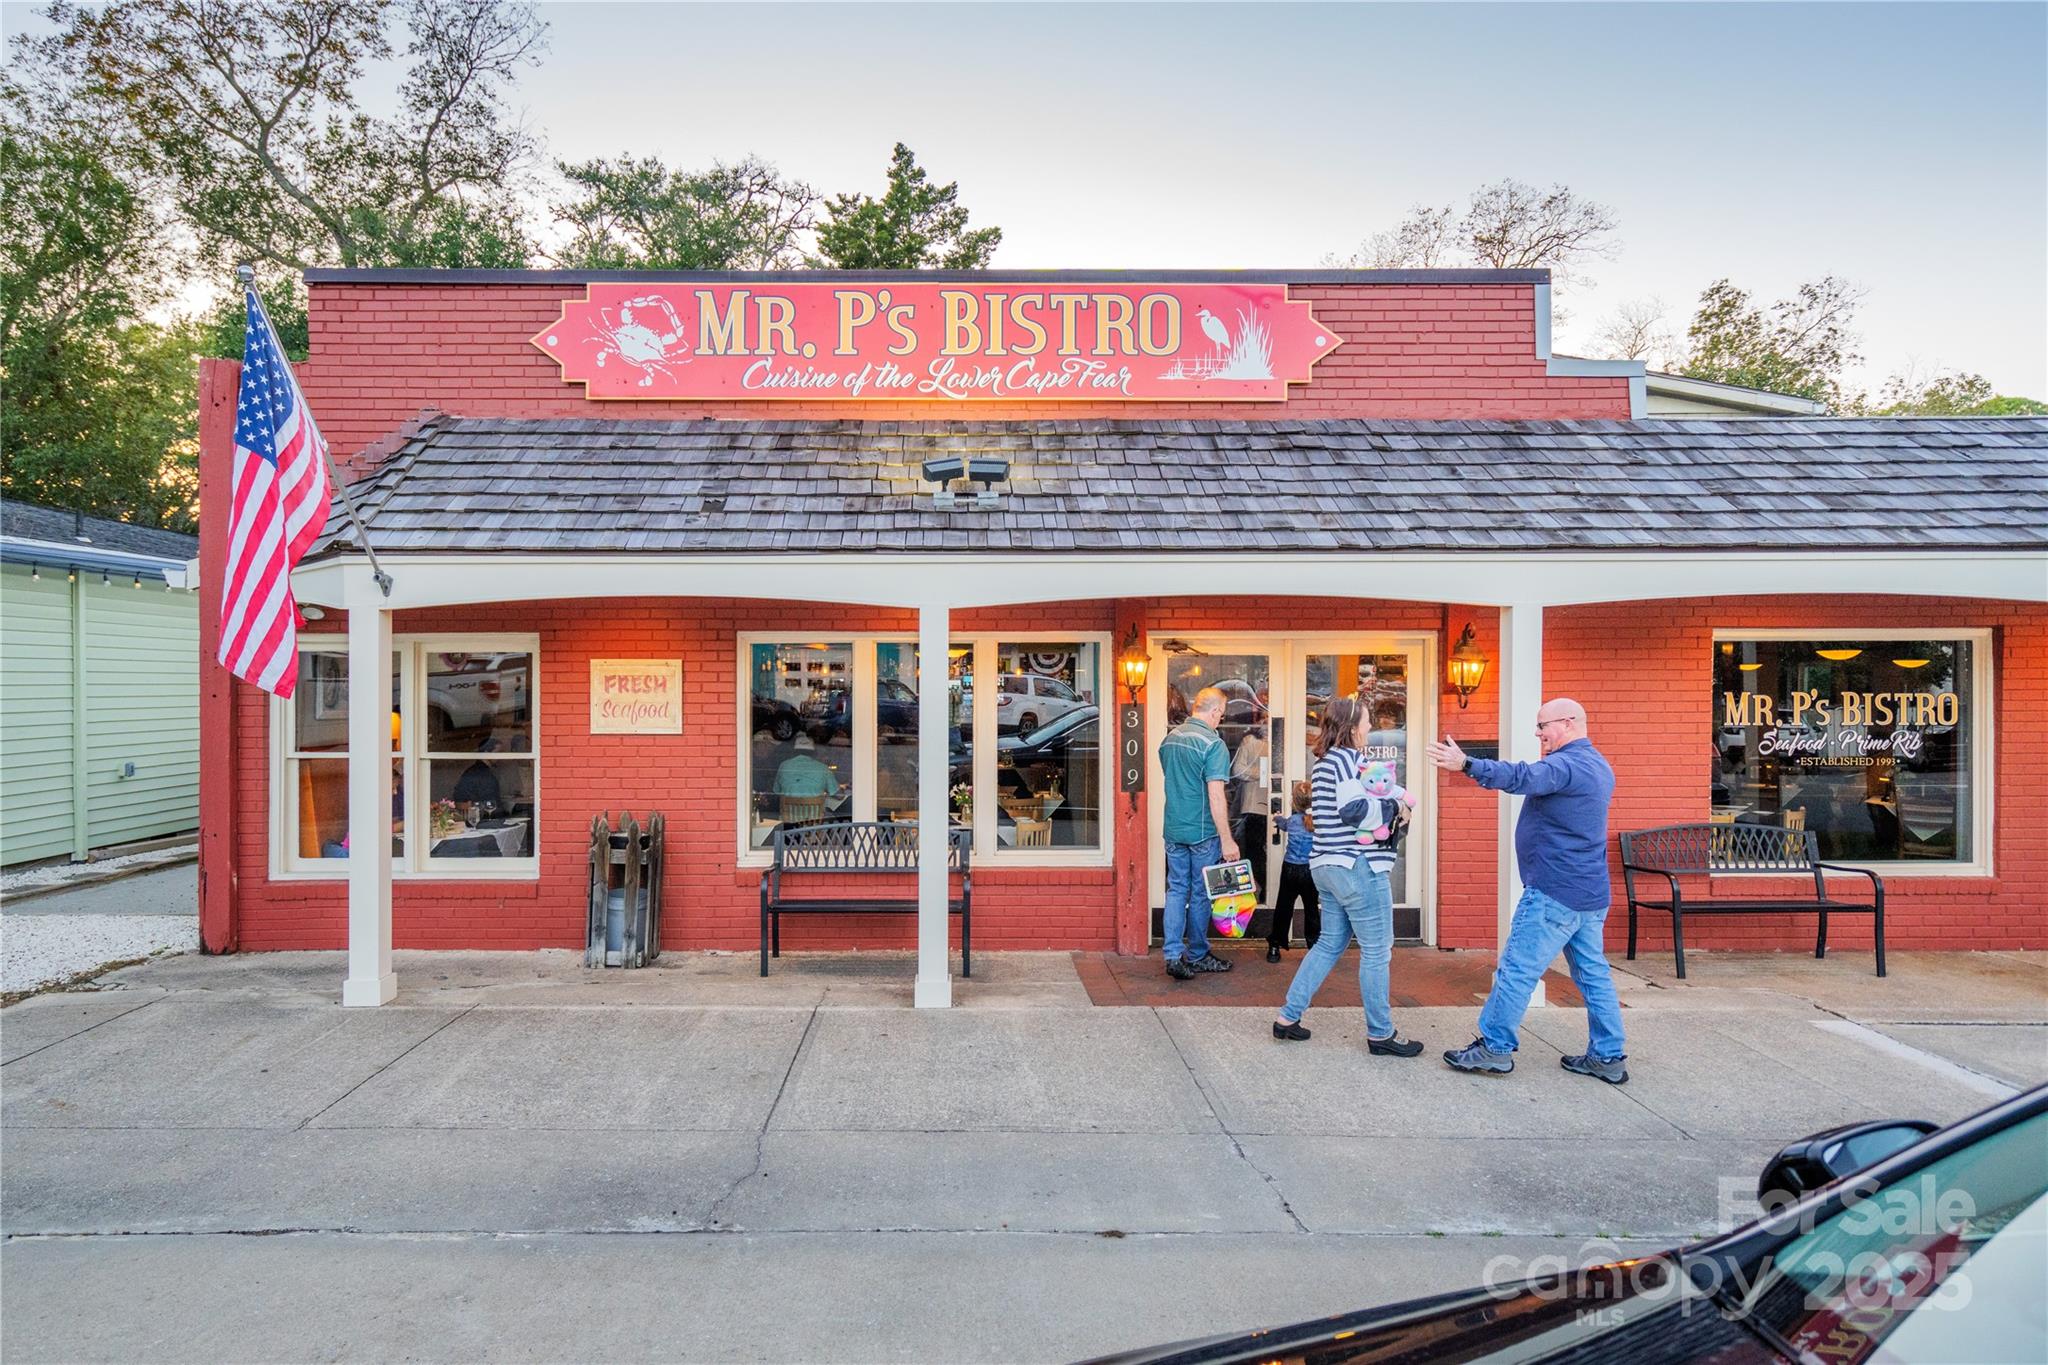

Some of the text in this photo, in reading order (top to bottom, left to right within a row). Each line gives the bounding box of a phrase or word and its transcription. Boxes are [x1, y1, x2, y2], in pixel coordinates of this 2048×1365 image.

[939, 290, 1182, 356] BISTRO
[742, 357, 1134, 400] Cuisine of the Lower Cape Fear
[604, 675, 668, 694] FRESH
[602, 699, 669, 725] Seafood
[1841, 691, 1959, 726] BISTRO
[1126, 710, 1139, 785] 309
[1758, 728, 1923, 758] Seafood Prime Rib
[1800, 757, 1874, 766] ESTABLISHED
